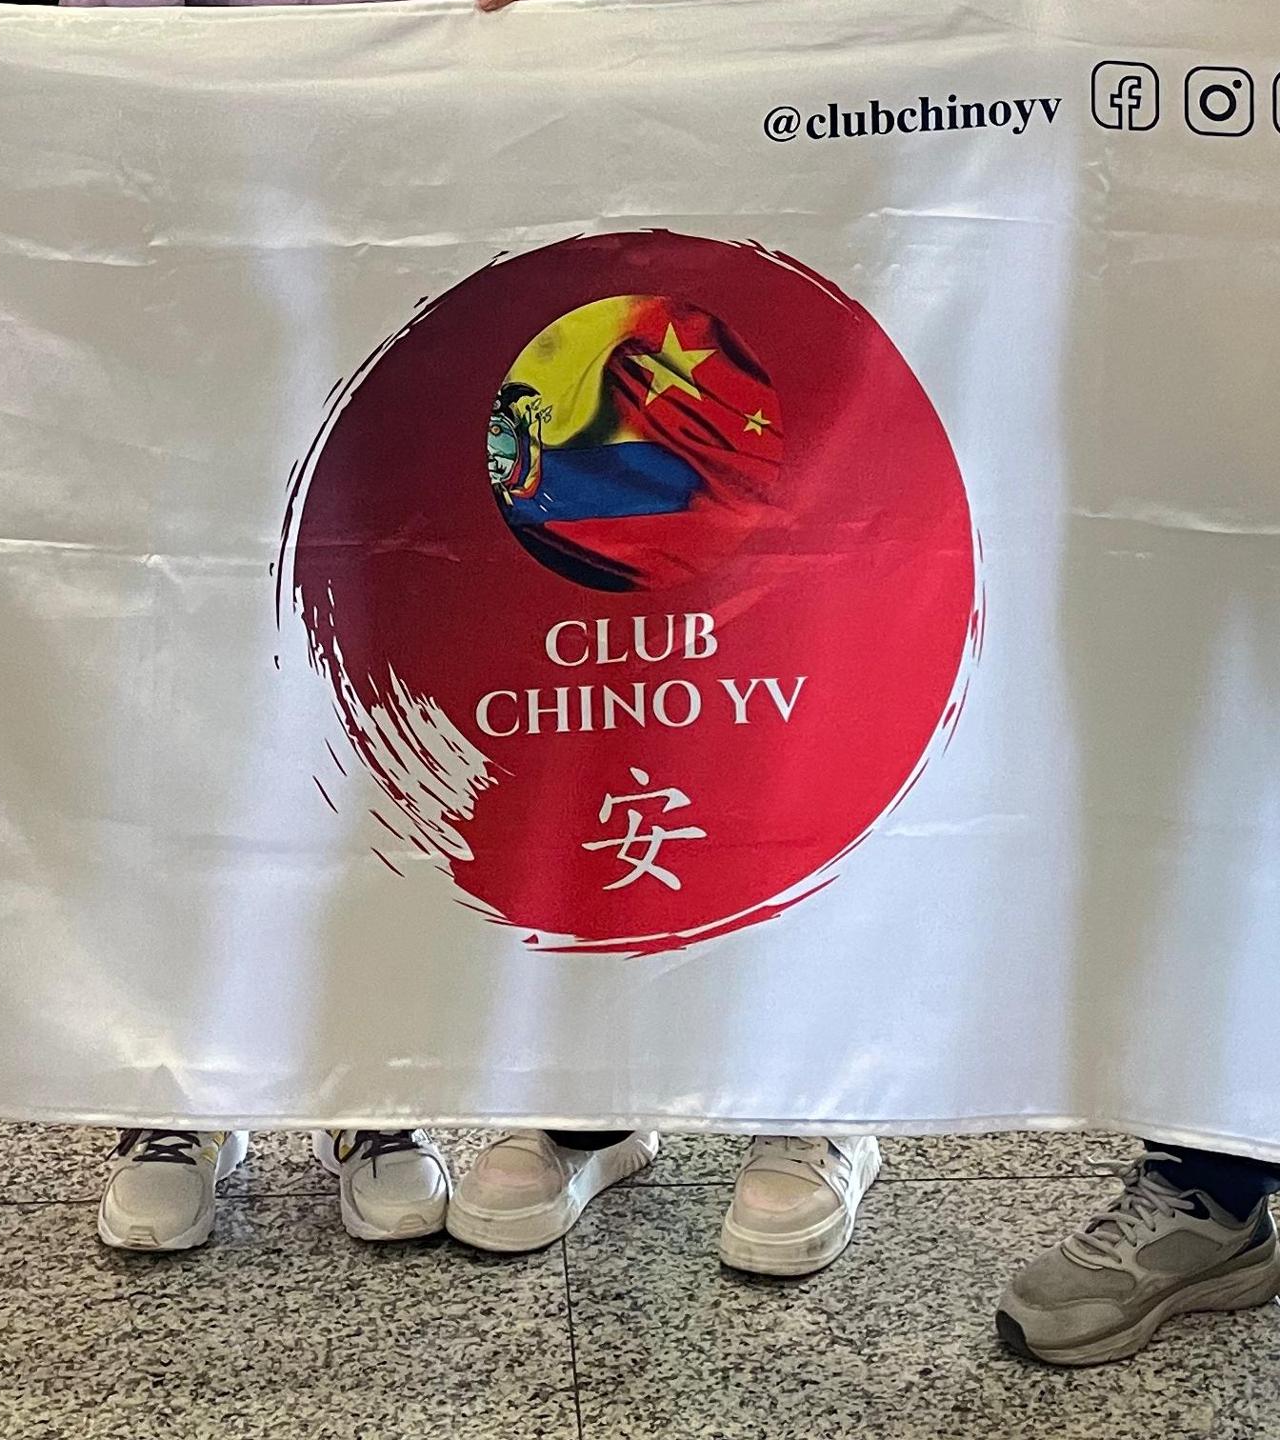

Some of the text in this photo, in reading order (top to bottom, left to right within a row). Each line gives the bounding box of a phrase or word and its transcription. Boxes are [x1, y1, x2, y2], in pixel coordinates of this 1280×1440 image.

[763, 93, 1063, 143] @clubchinoyv
[545, 613, 718, 667] CLUB
[475, 675, 808, 737] CHINO YV
[582, 766, 708, 891] 安
